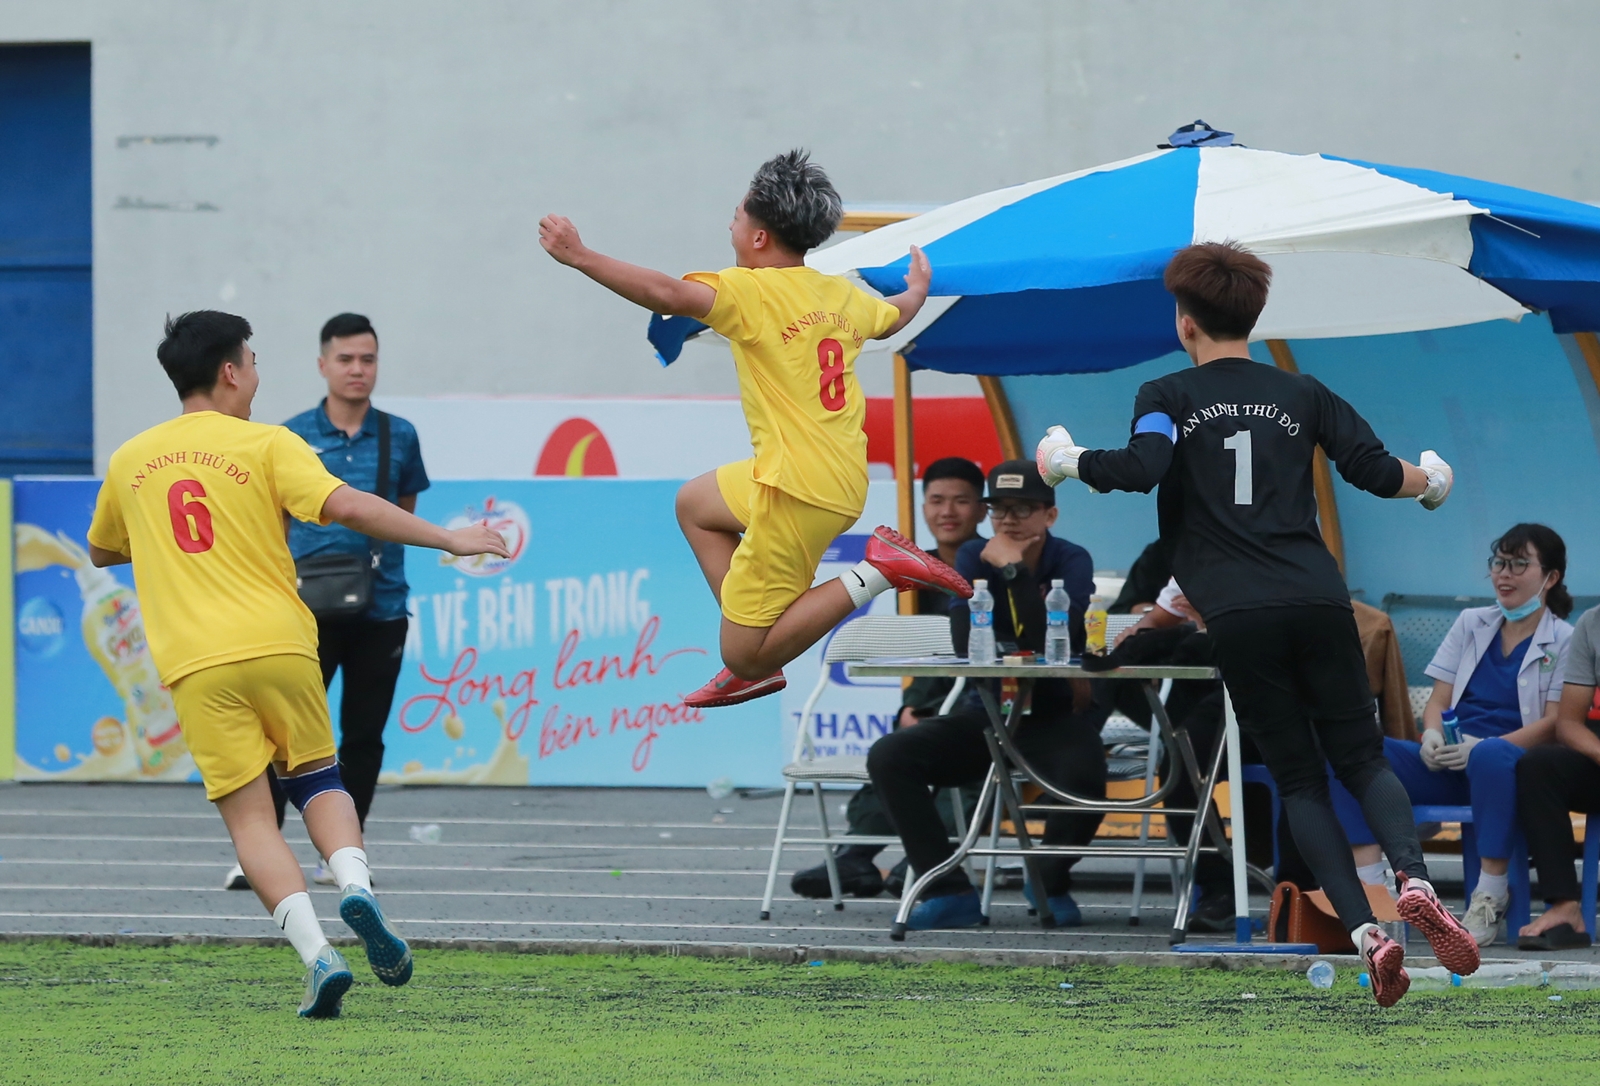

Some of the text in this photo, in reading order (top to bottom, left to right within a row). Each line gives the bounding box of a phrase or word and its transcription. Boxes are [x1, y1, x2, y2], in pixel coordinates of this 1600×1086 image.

[781, 322, 800, 345] AN
[797, 310, 829, 330] NINH
[829, 312, 851, 333] THỦ
[817, 337, 847, 412] 8
[1182, 402, 1301, 438] AN NINH THỦ ĐÔ
[130, 451, 251, 495] AN NINH THỦ ĐÔ
[1223, 429, 1253, 505] 1
[167, 479, 215, 554] 6
[477, 576, 535, 652] BÊN
[545, 568, 650, 646] TRONG
[399, 615, 708, 742] Long lanh
[538, 704, 600, 760] bên
